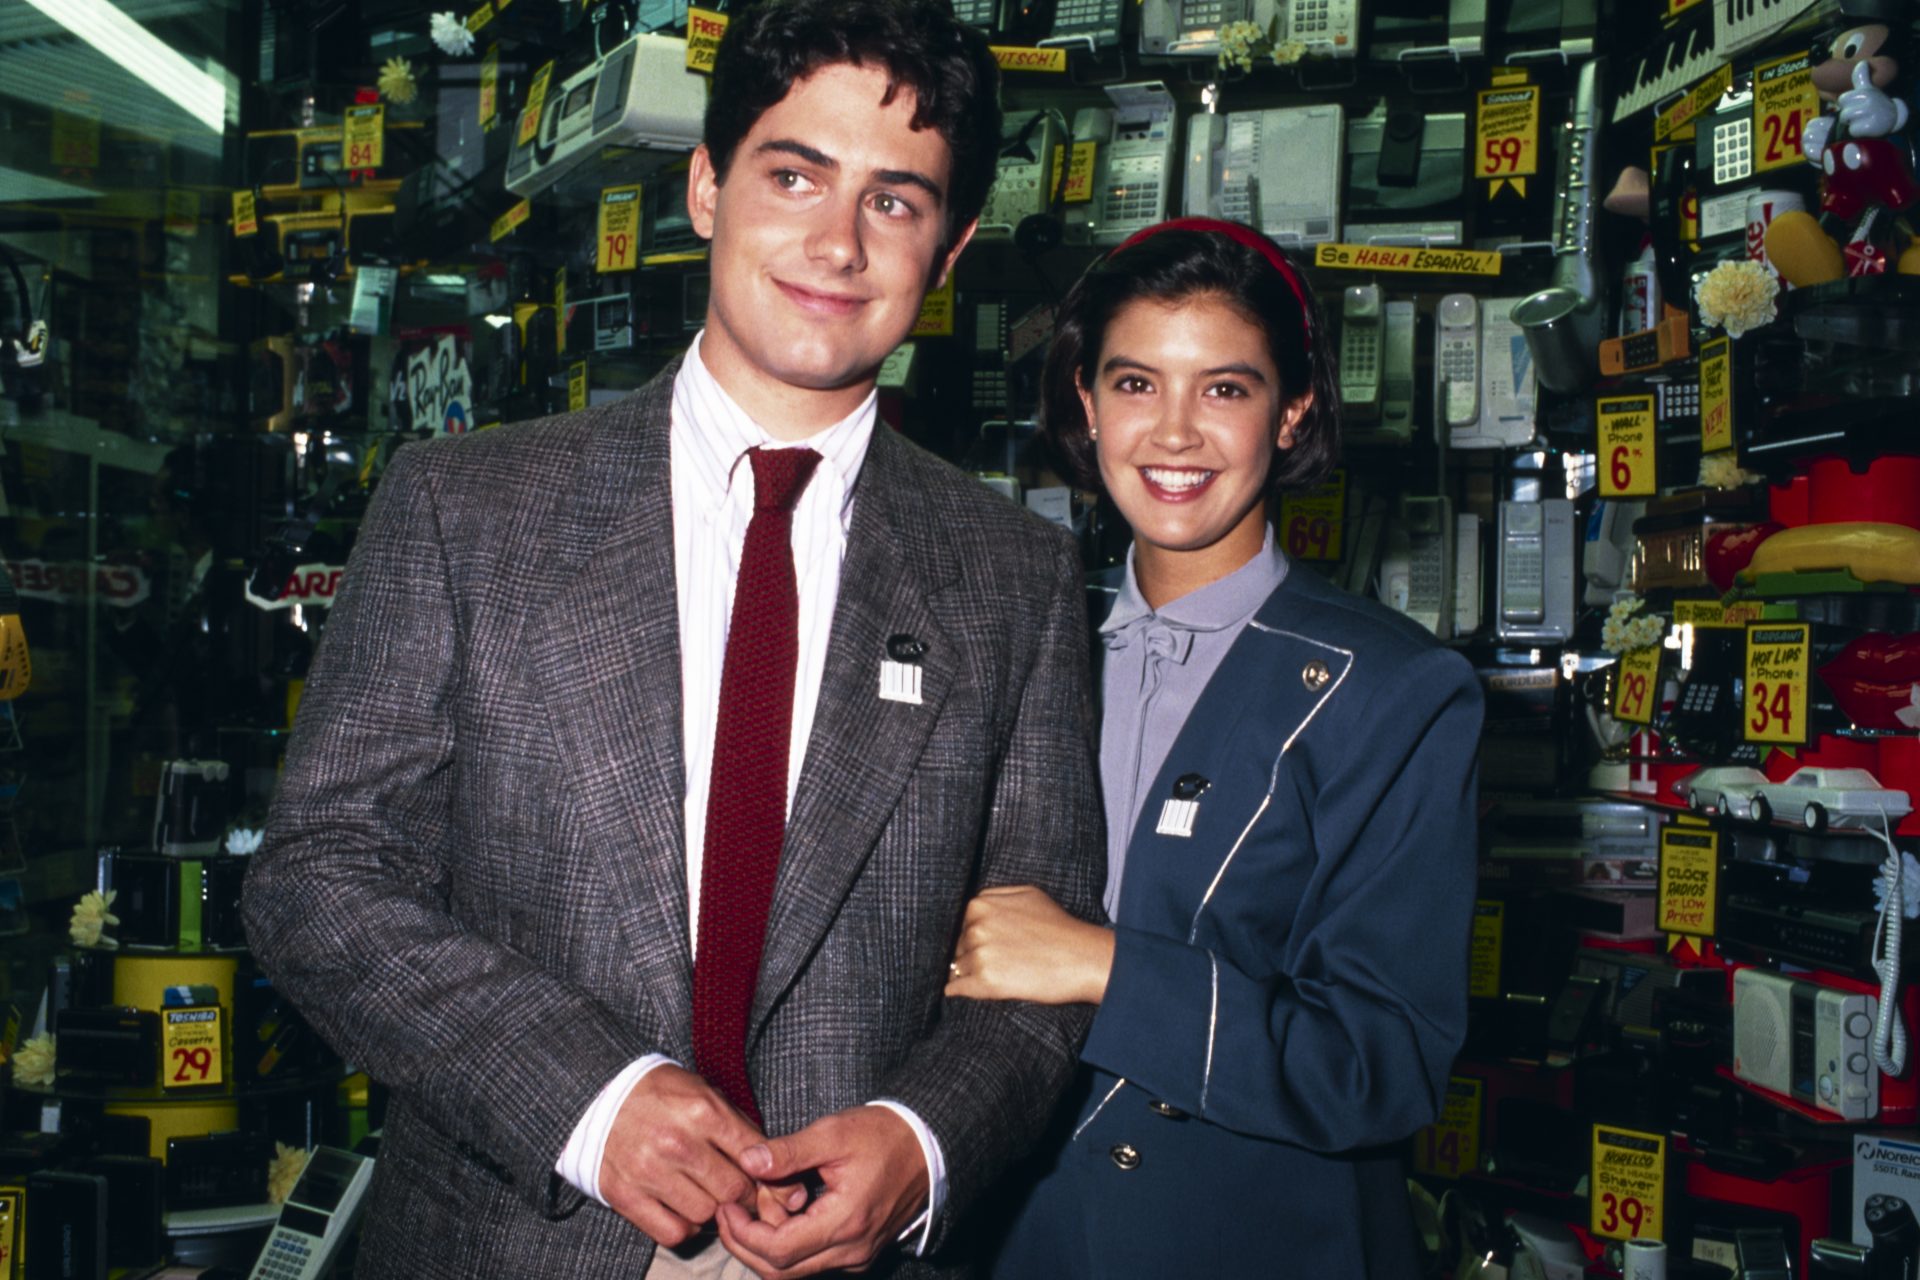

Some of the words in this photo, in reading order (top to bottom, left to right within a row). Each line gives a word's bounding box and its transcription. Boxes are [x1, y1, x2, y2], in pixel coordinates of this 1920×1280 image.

[997, 51, 1058, 67] UTSCH!
[1765, 95, 1803, 112] Phone
[1763, 109, 1804, 163] 24
[1485, 137, 1521, 174] 59
[1321, 247, 1349, 264] Se
[1355, 250, 1410, 267] HABLA
[1413, 252, 1493, 273] ESPAÑOL!
[1608, 432, 1643, 444] Phone
[1611, 445, 1631, 491] 6
[1288, 516, 1330, 560] 69
[1751, 651, 1773, 667] HOT
[1774, 648, 1802, 665] LIPS
[1757, 668, 1794, 680] Phone
[1620, 672, 1646, 716] 29
[1751, 682, 1792, 735] 34
[1666, 867, 1709, 883] CLOCK
[1666, 881, 1708, 897] RADIOS
[1682, 899, 1706, 910] LOW
[1665, 909, 1705, 927] Prices
[169, 1011, 216, 1023] TOSHIBA
[173, 1048, 212, 1081] 29
[1427, 1131, 1459, 1174] 14
[1604, 1149, 1655, 1169] NORELCO
[1600, 1172, 1655, 1190] Shaver
[1601, 1192, 1644, 1238] 39
